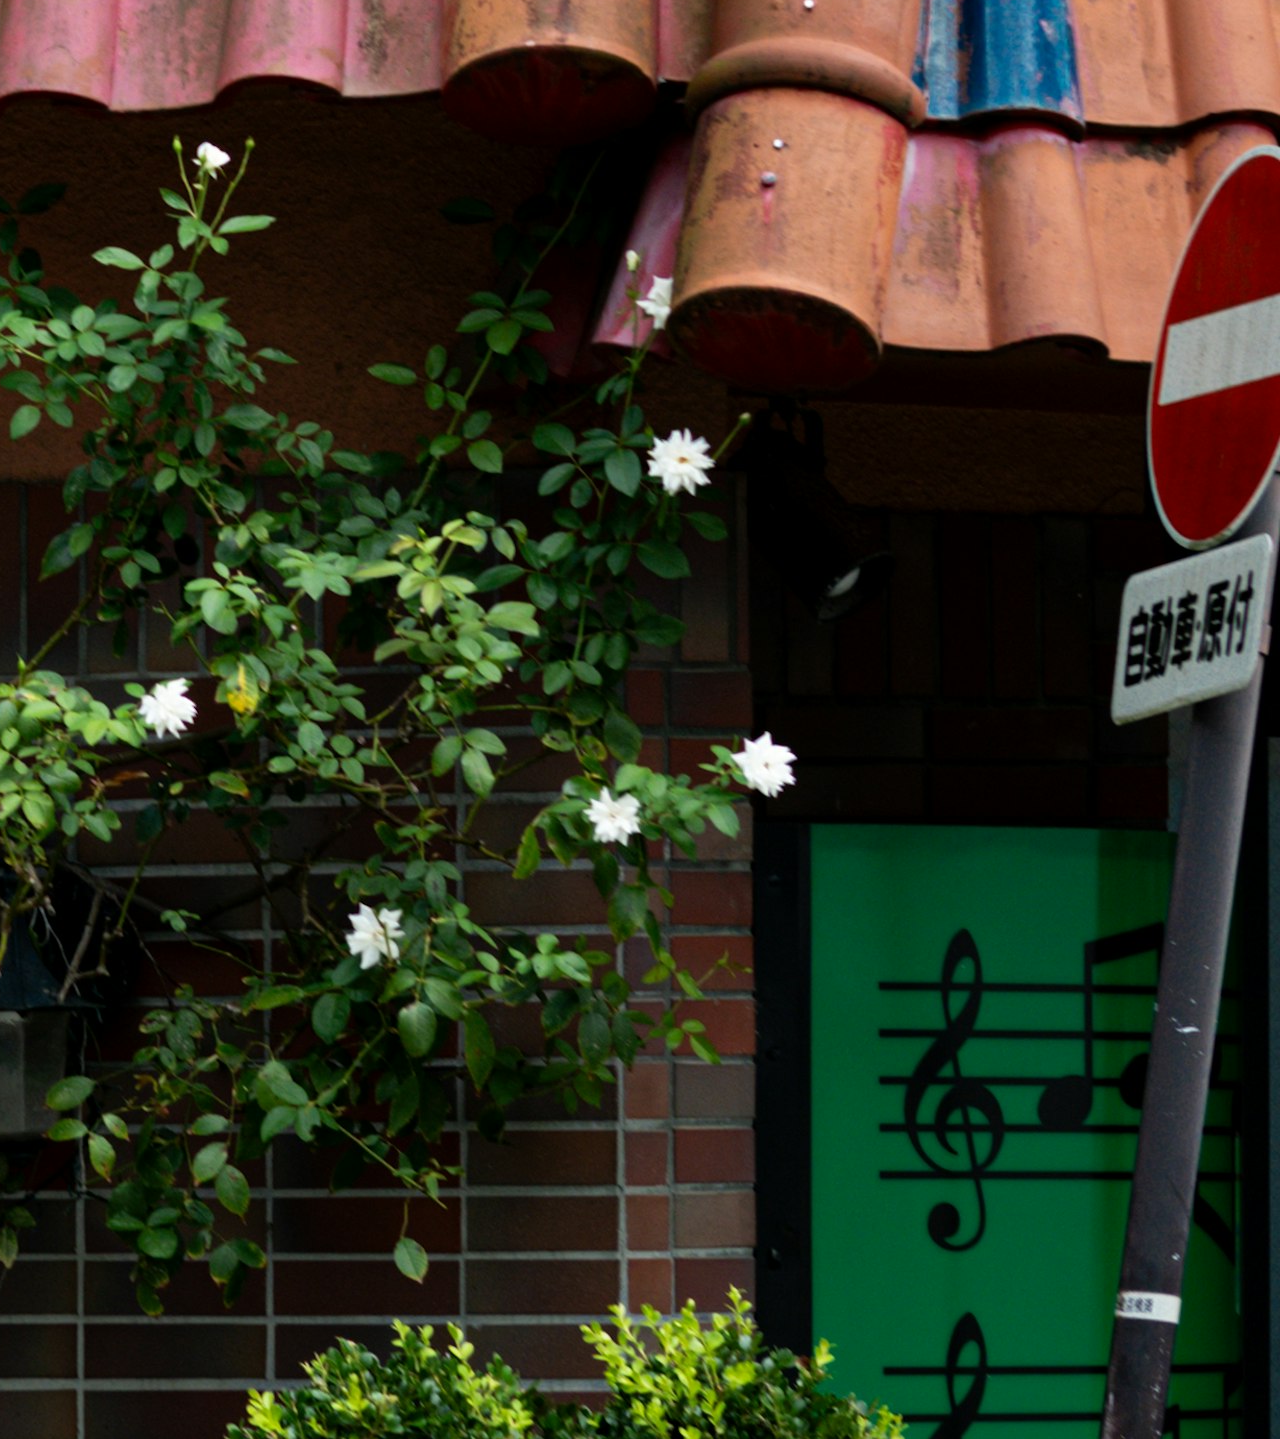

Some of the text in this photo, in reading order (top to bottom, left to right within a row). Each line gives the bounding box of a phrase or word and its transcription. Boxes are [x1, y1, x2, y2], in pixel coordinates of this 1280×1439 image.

[1124, 569, 1254, 687] 自動車・原付
